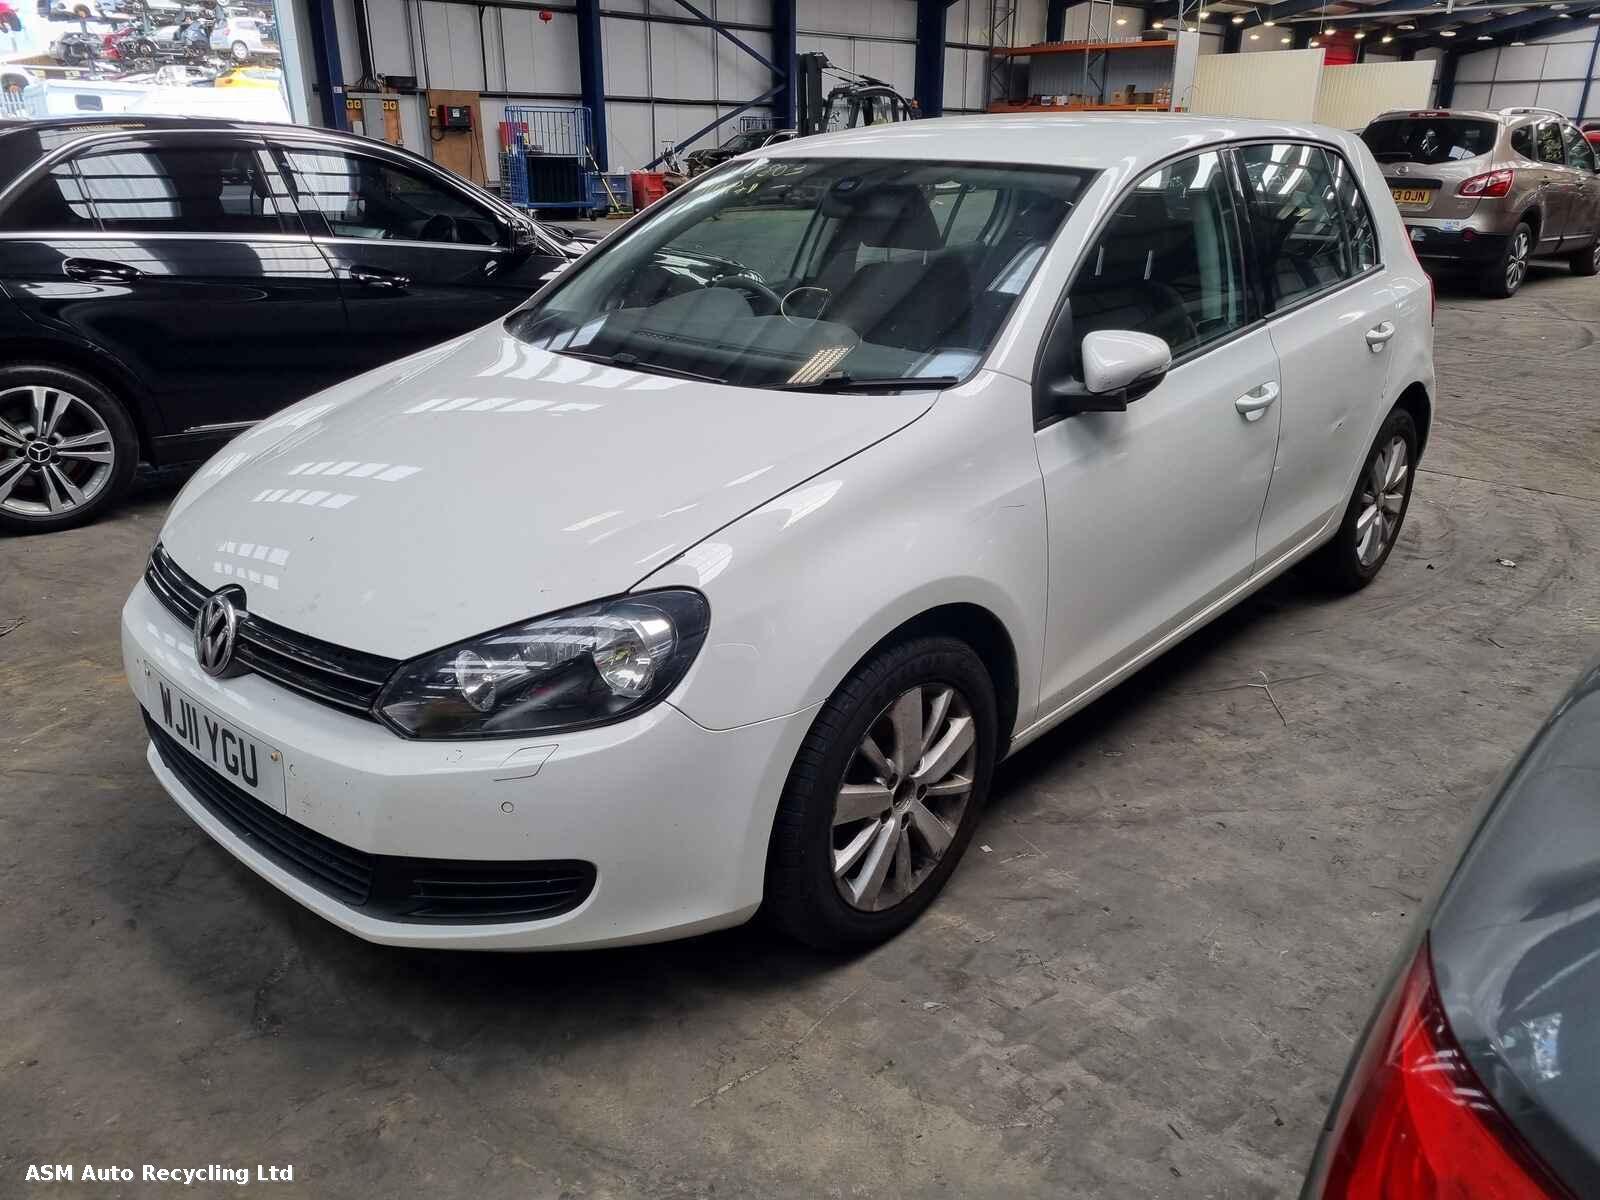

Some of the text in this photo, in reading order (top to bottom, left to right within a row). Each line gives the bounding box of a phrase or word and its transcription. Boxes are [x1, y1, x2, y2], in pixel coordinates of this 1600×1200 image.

[1404, 190, 1426, 202] OJN
[160, 682, 258, 788] WJ11 YGU
